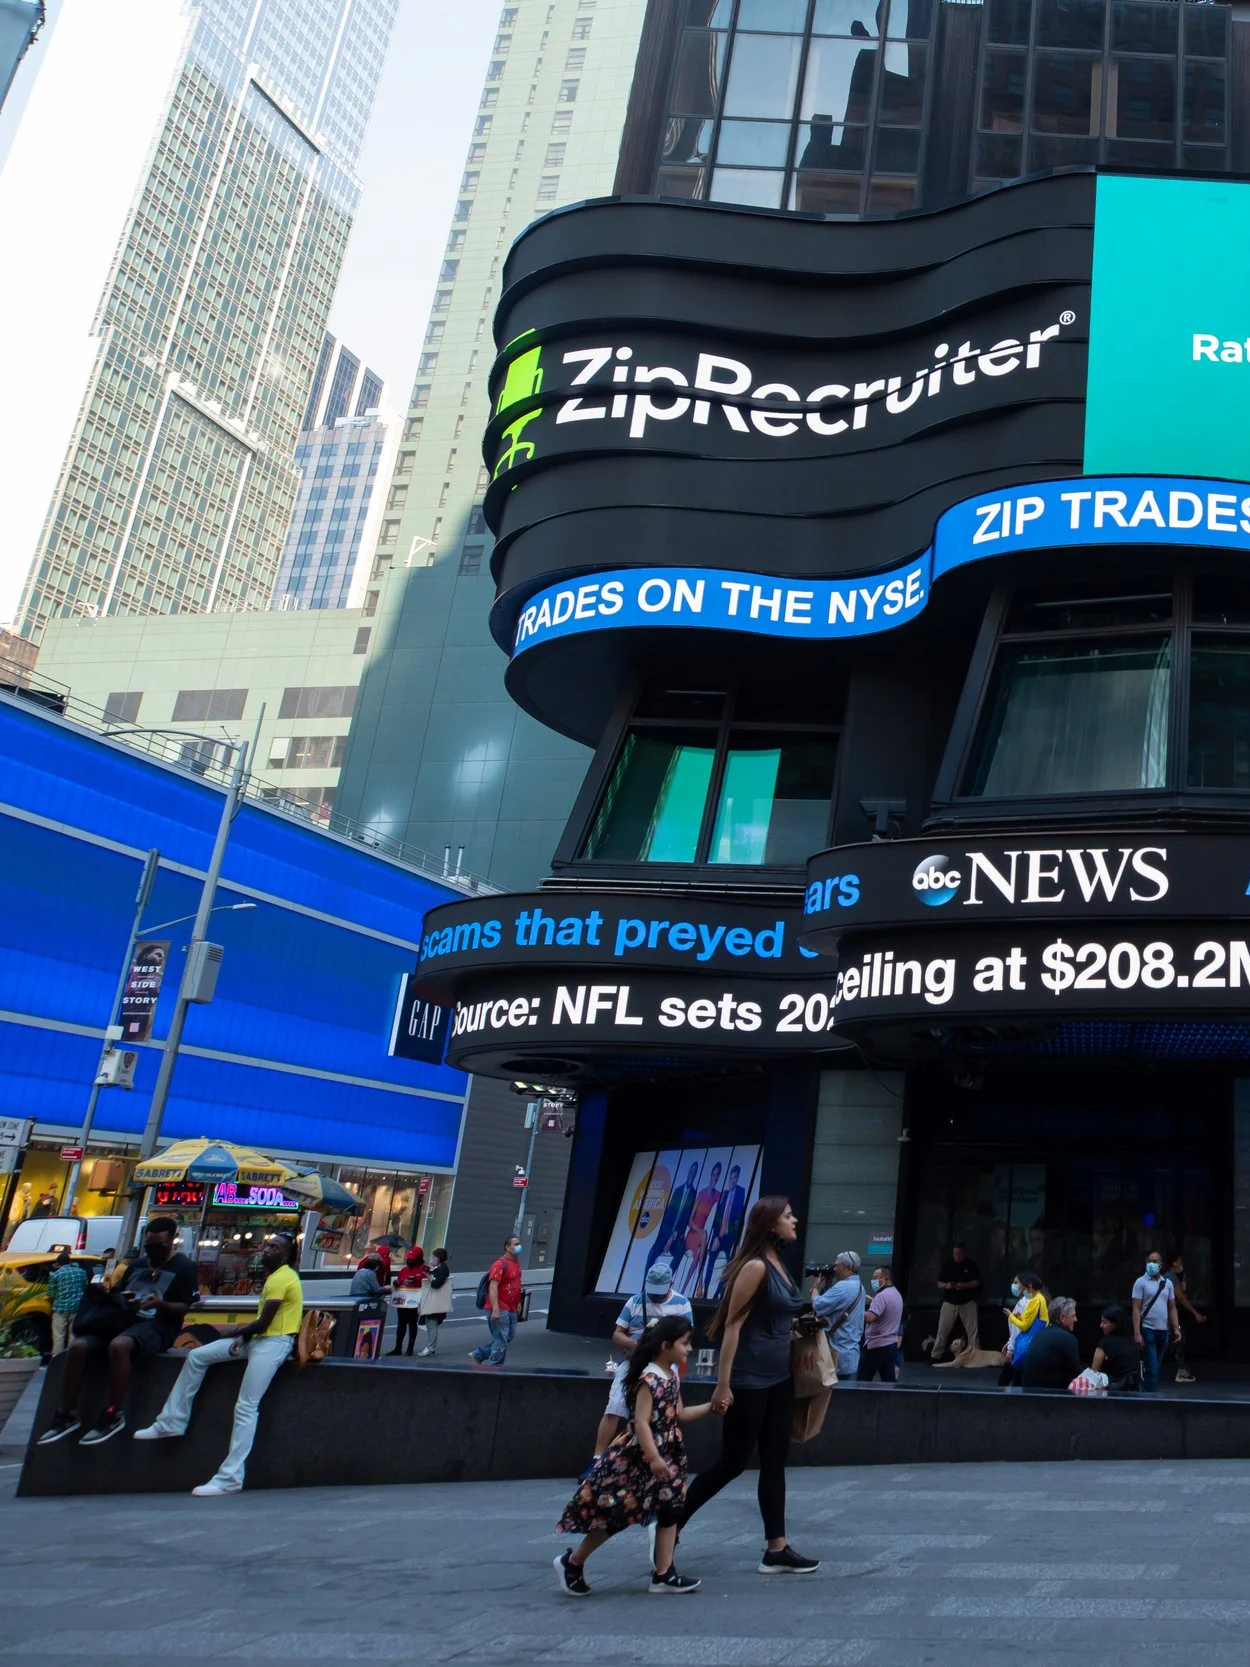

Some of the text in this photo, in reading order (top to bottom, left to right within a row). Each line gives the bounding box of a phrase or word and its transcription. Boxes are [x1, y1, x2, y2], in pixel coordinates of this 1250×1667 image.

[971, 495, 1044, 545] ZIP
[515, 569, 925, 648] TRADES ON THE NYSE.
[912, 869, 961, 892] abc
[963, 847, 1169, 905] NEWS
[420, 919, 502, 962] scams
[515, 908, 603, 946] that
[614, 918, 785, 961] preyed
[133, 965, 162, 973] WEST
[836, 951, 956, 1005] ceiling
[973, 948, 1026, 991] at
[408, 1000, 441, 1041] GAP
[552, 985, 643, 1025] NFL
[658, 993, 762, 1032] sets
[135, 1168, 182, 1179] SABRETT
[241, 1170, 282, 1182] SABRETT
[249, 1186, 284, 1204] SODA
